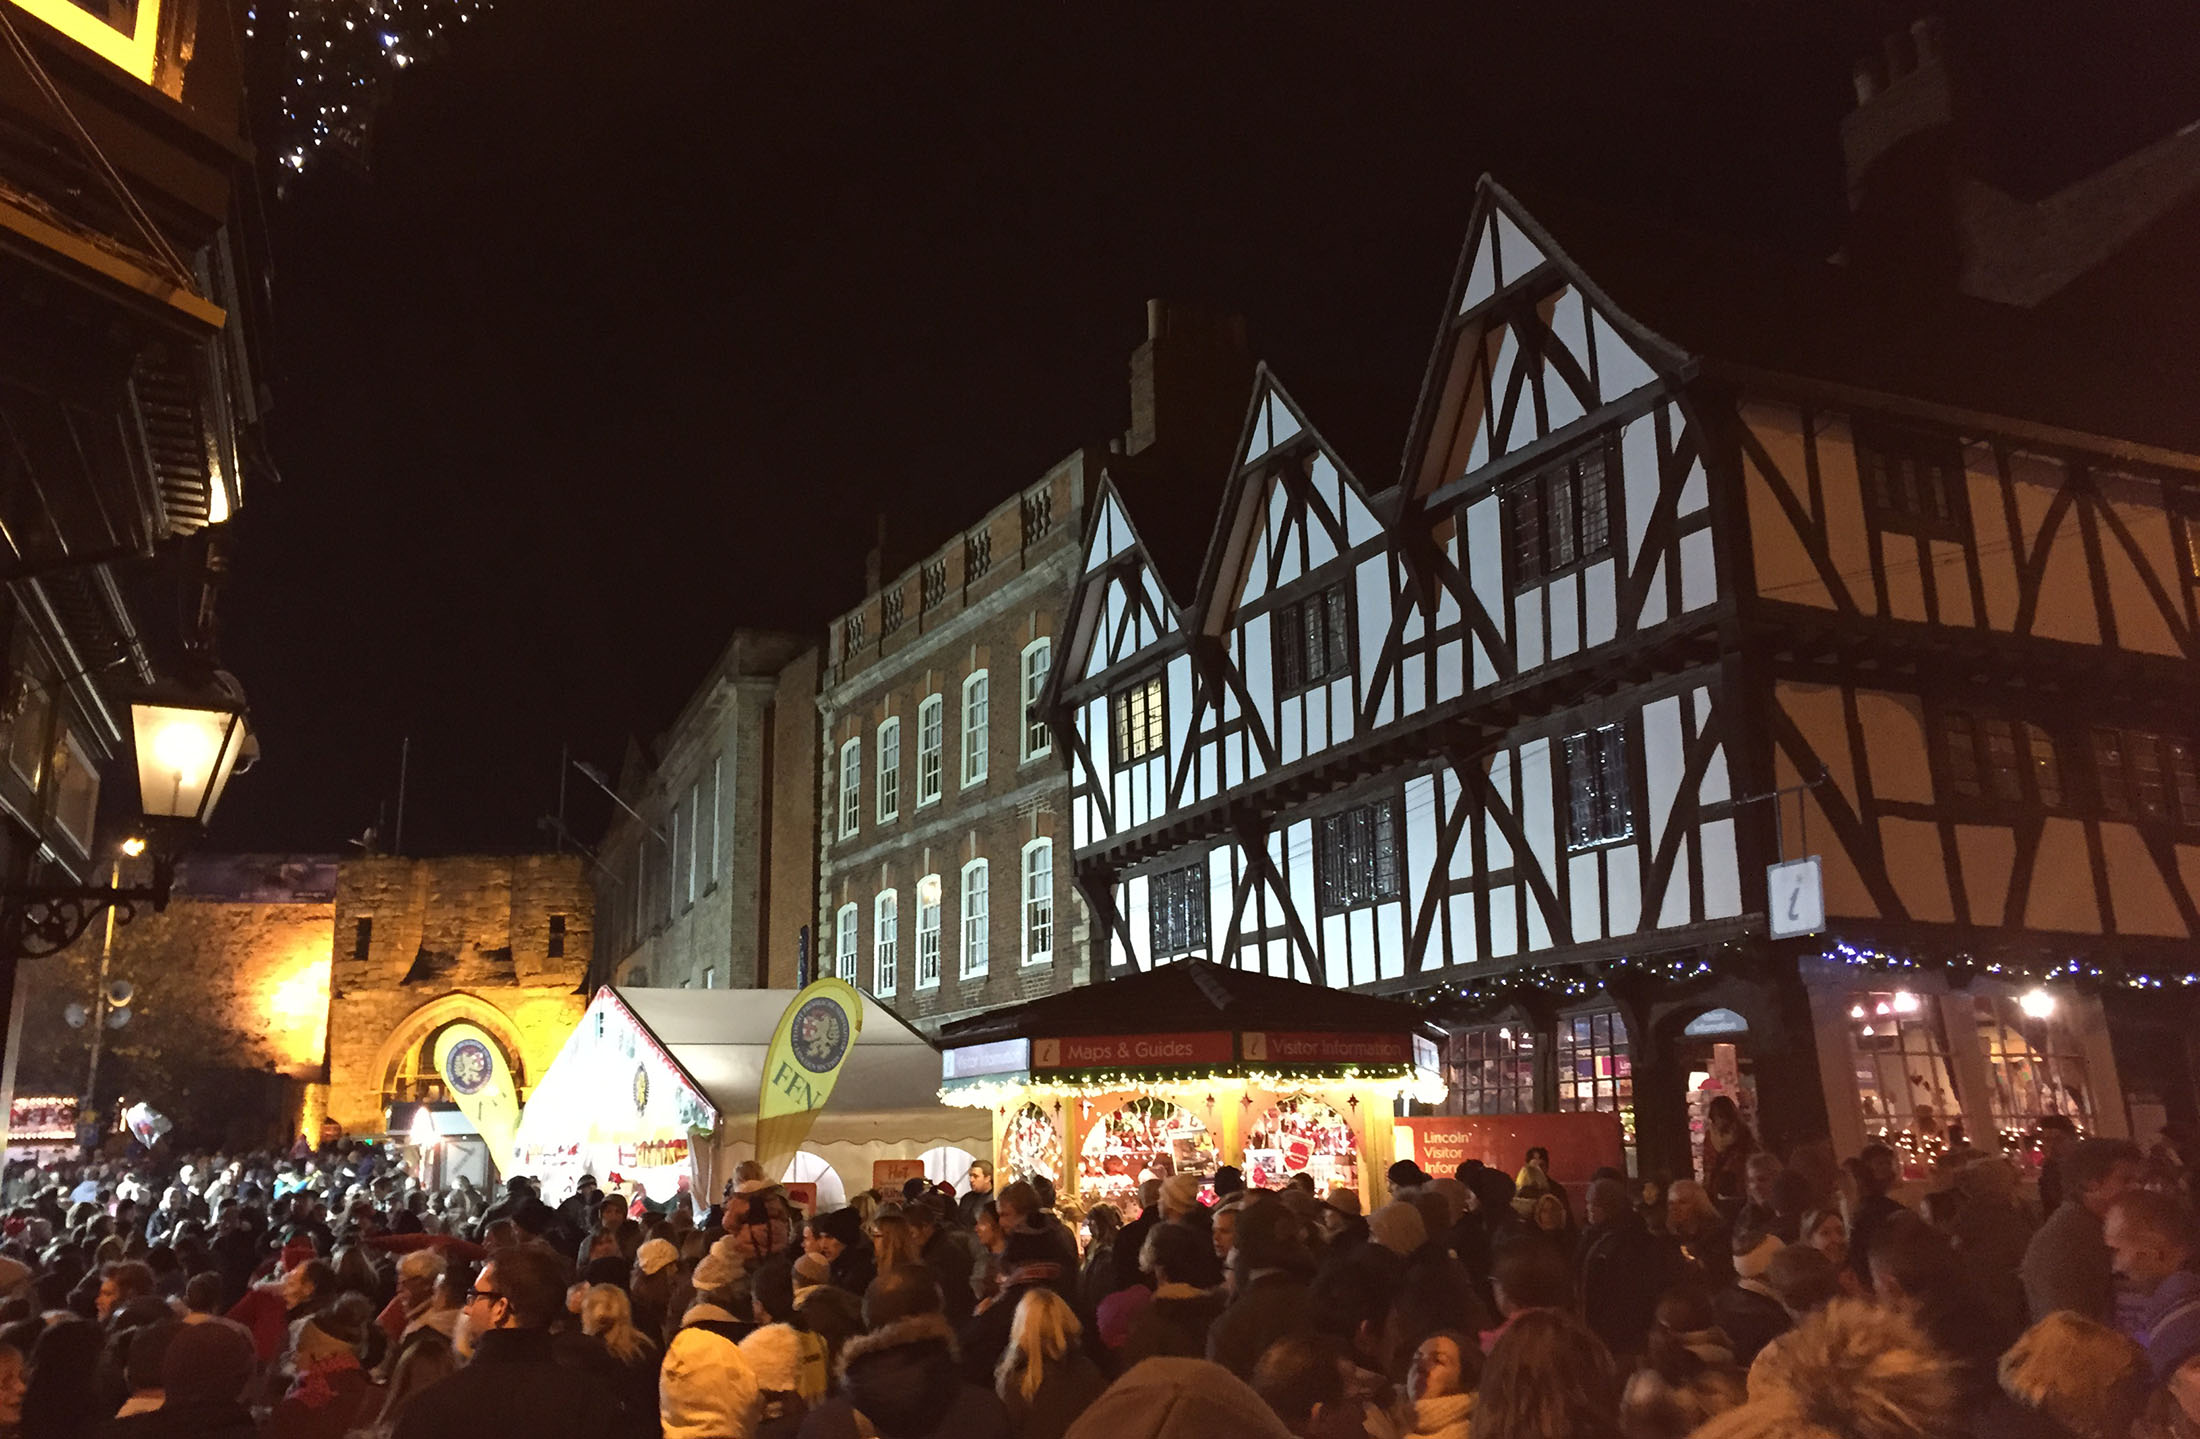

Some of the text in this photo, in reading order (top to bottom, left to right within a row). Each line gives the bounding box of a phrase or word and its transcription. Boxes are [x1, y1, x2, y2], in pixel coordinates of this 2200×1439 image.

[1067, 1045, 1112, 1062] Maps
[1117, 1041, 1131, 1058] &
[1135, 1040, 1193, 1058] Guides
[1272, 1039, 1319, 1055] Visitor
[1322, 1038, 1401, 1057] Information
[772, 1061, 822, 1110] FFN
[1423, 1131, 1469, 1144] Lincoln
[1423, 1146, 1463, 1159] Visitor
